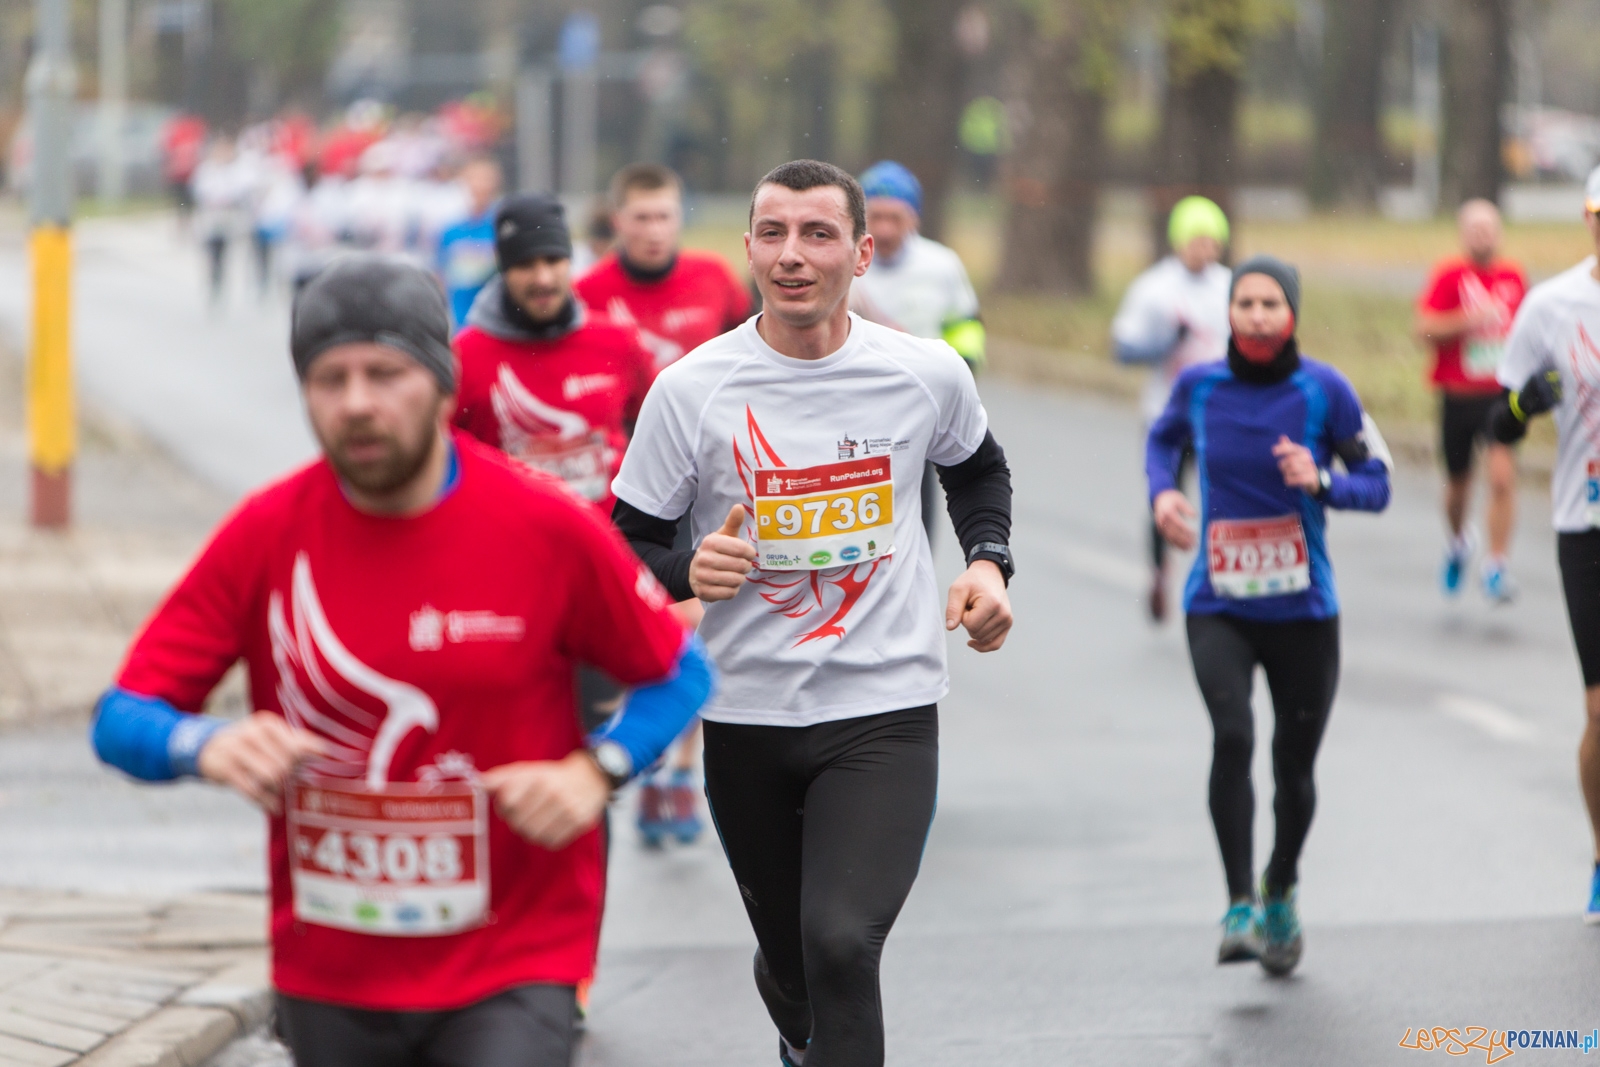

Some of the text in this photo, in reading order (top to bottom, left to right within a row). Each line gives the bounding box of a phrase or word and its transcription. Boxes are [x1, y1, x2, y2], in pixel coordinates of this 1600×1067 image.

[829, 468, 884, 482] RunPoland.org
[760, 492, 881, 536] D 9736
[1222, 541, 1299, 574] 7029
[313, 831, 463, 882] 4308
